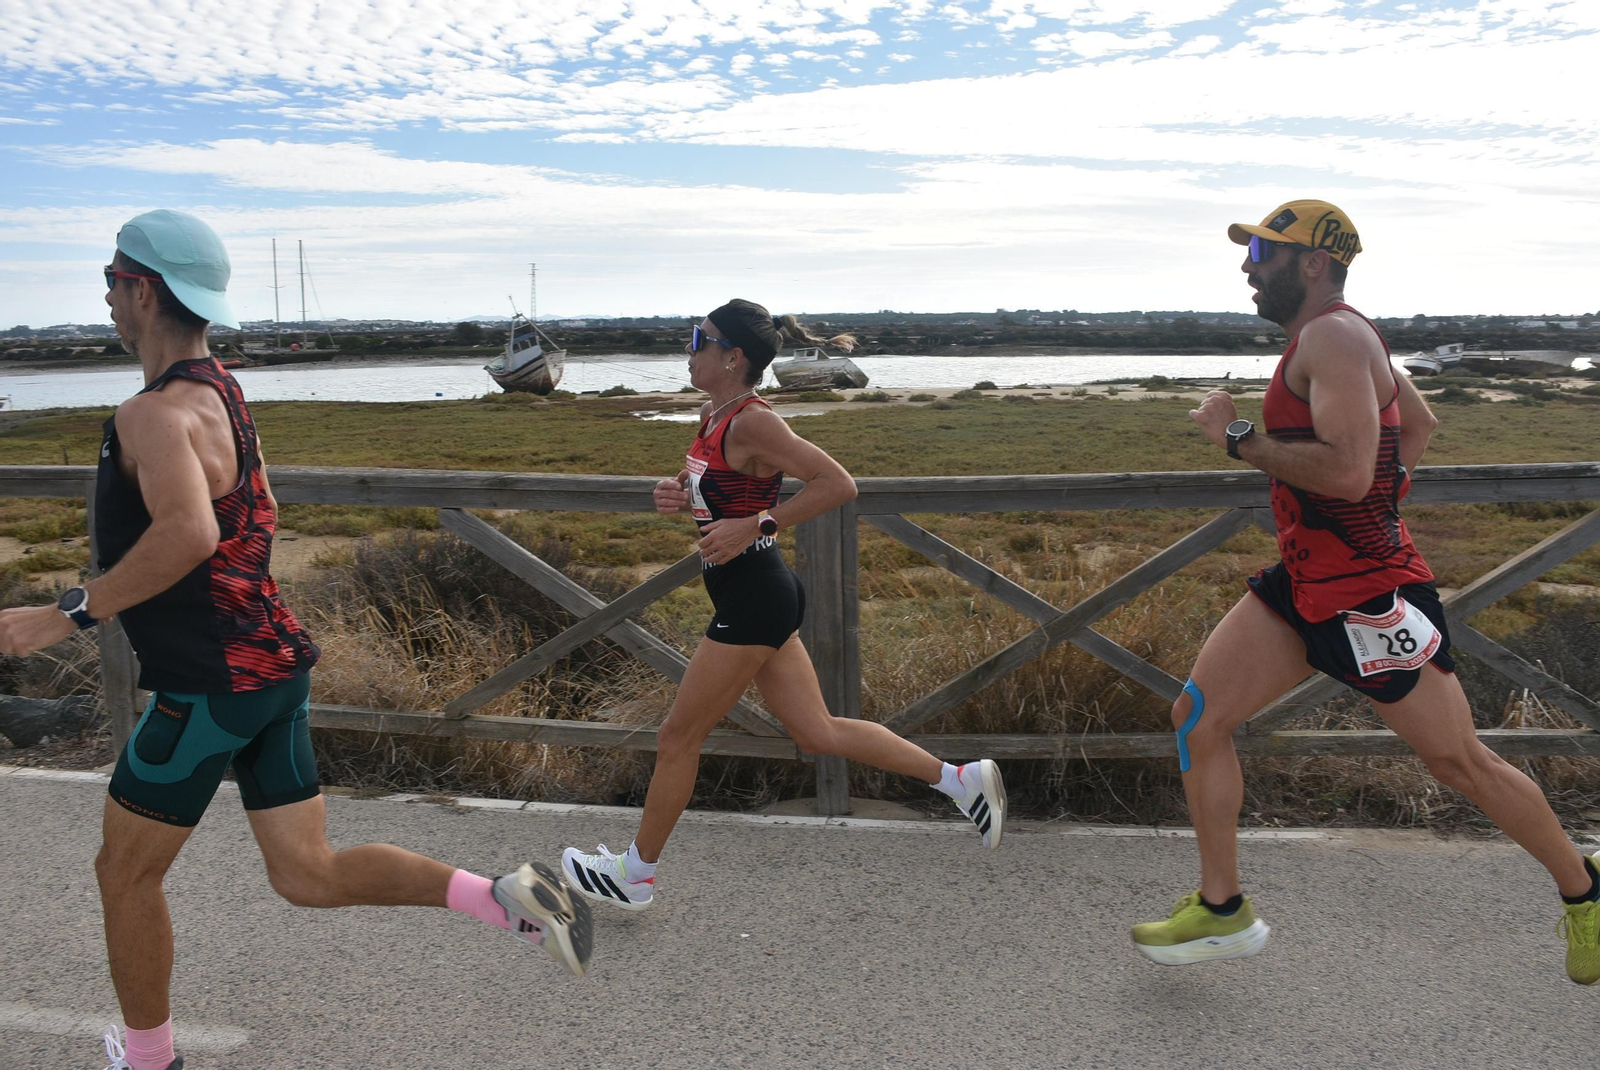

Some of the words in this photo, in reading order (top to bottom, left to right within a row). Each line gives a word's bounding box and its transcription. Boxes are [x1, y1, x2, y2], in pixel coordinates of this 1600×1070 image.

[1377, 628, 1417, 656] 28
[157, 703, 182, 718] WONG
[120, 796, 165, 819] WONG
